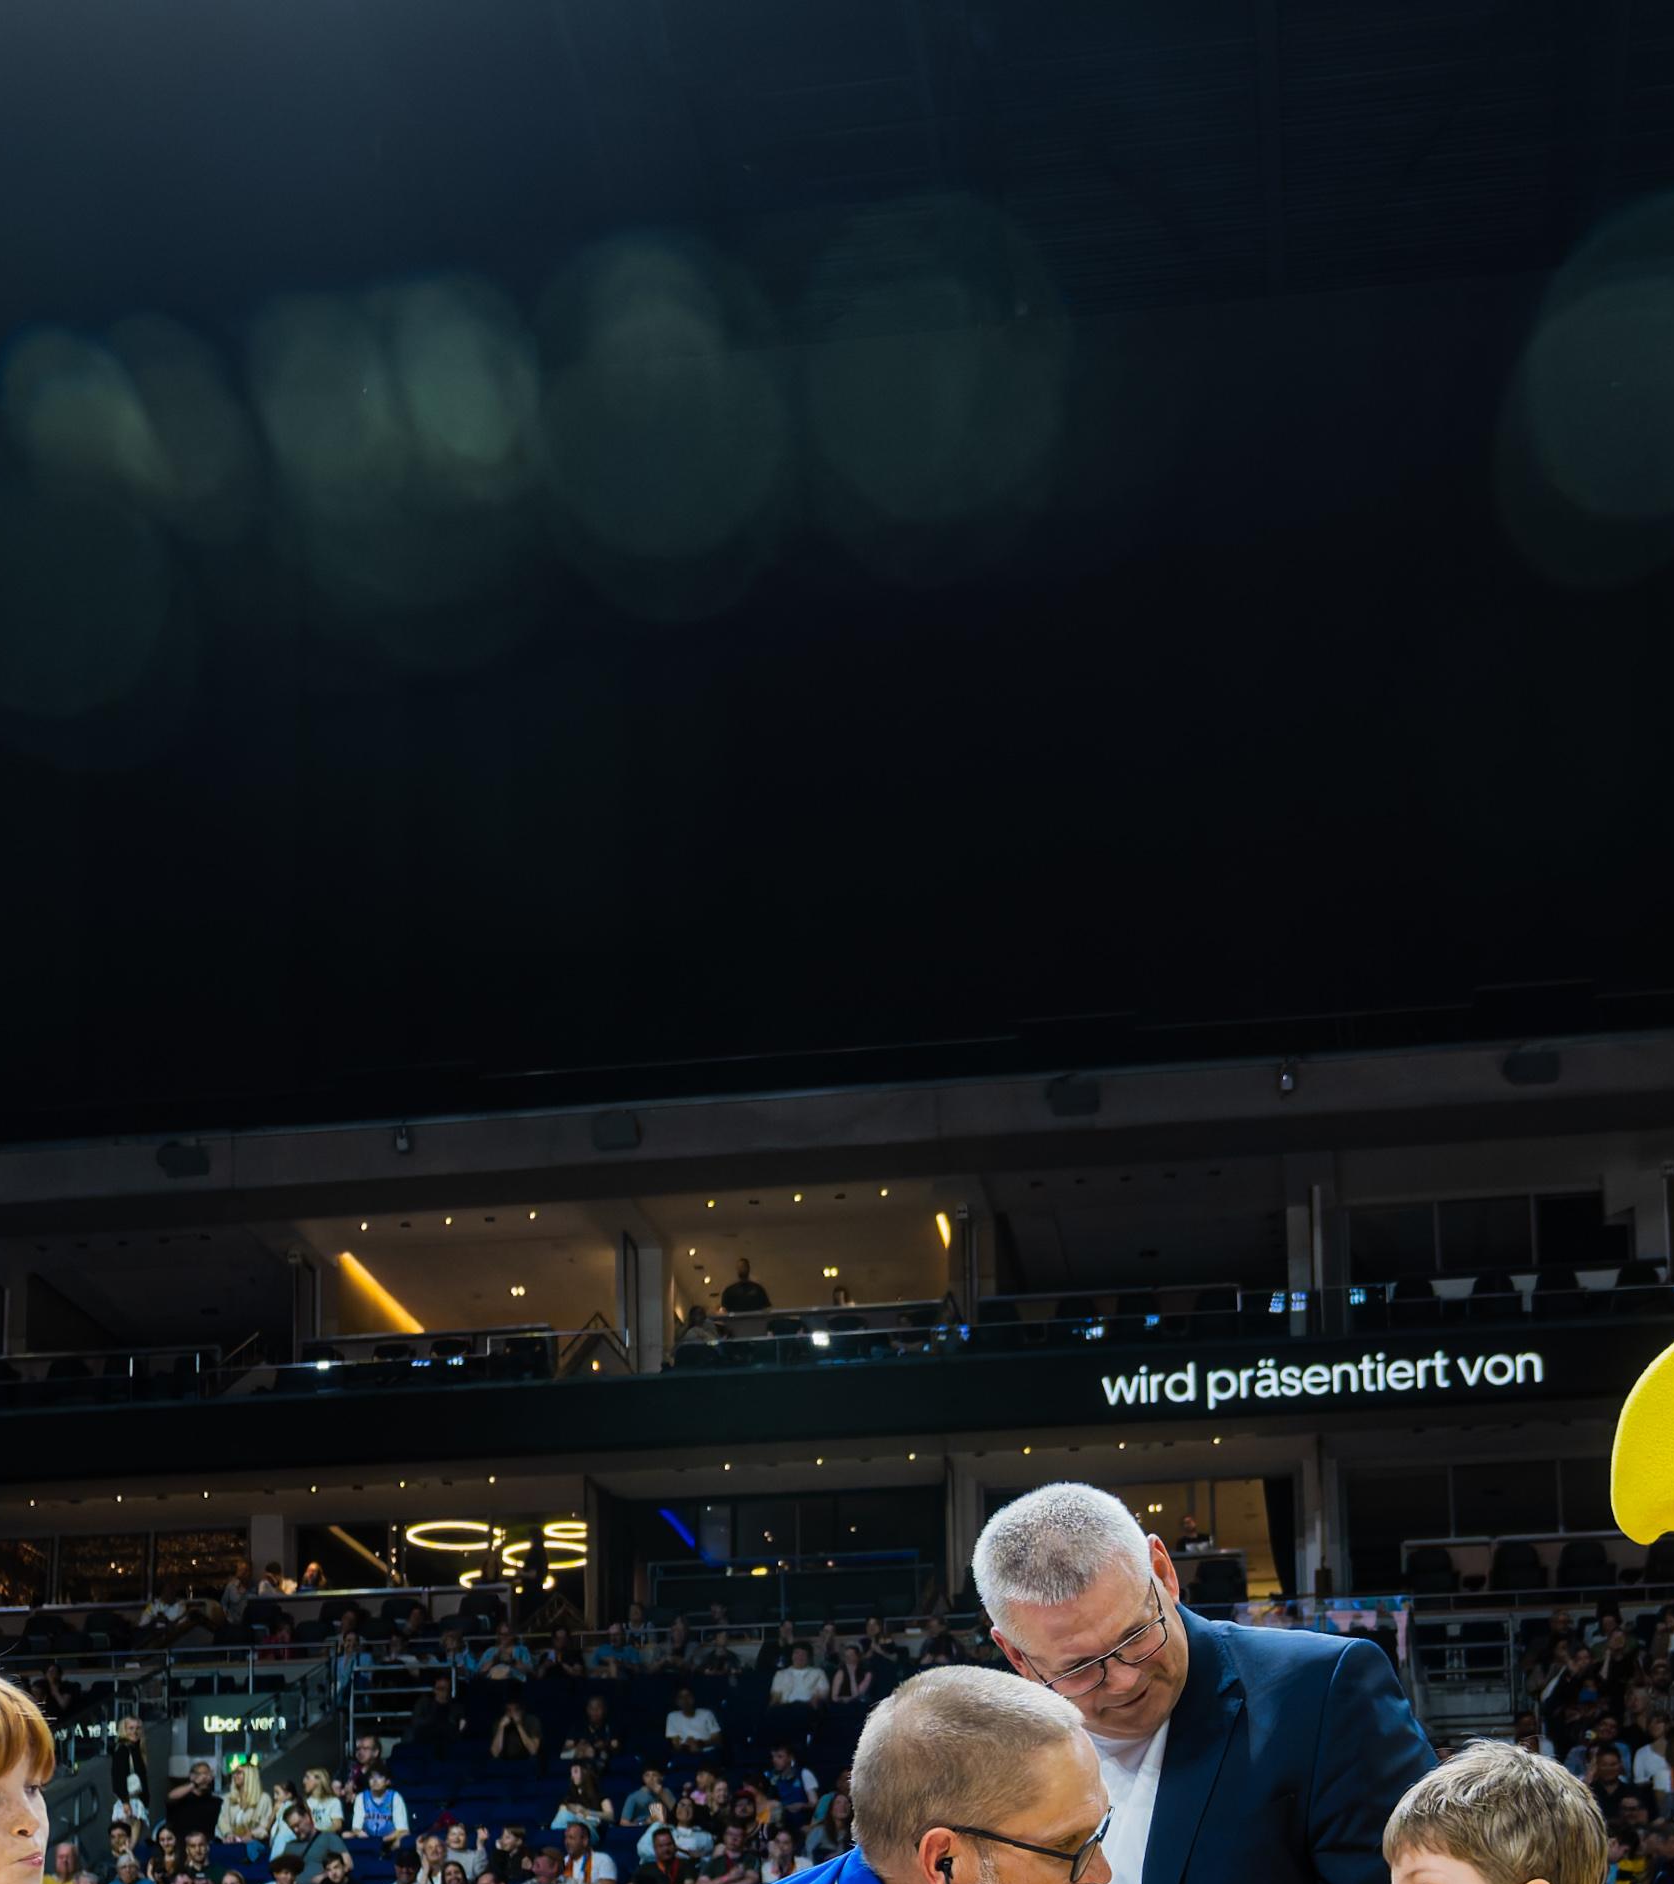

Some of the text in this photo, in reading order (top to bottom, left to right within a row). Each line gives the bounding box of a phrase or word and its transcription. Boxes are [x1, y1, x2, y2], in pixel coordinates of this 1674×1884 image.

[1101, 1349, 1545, 1411] wird präsentiert von
